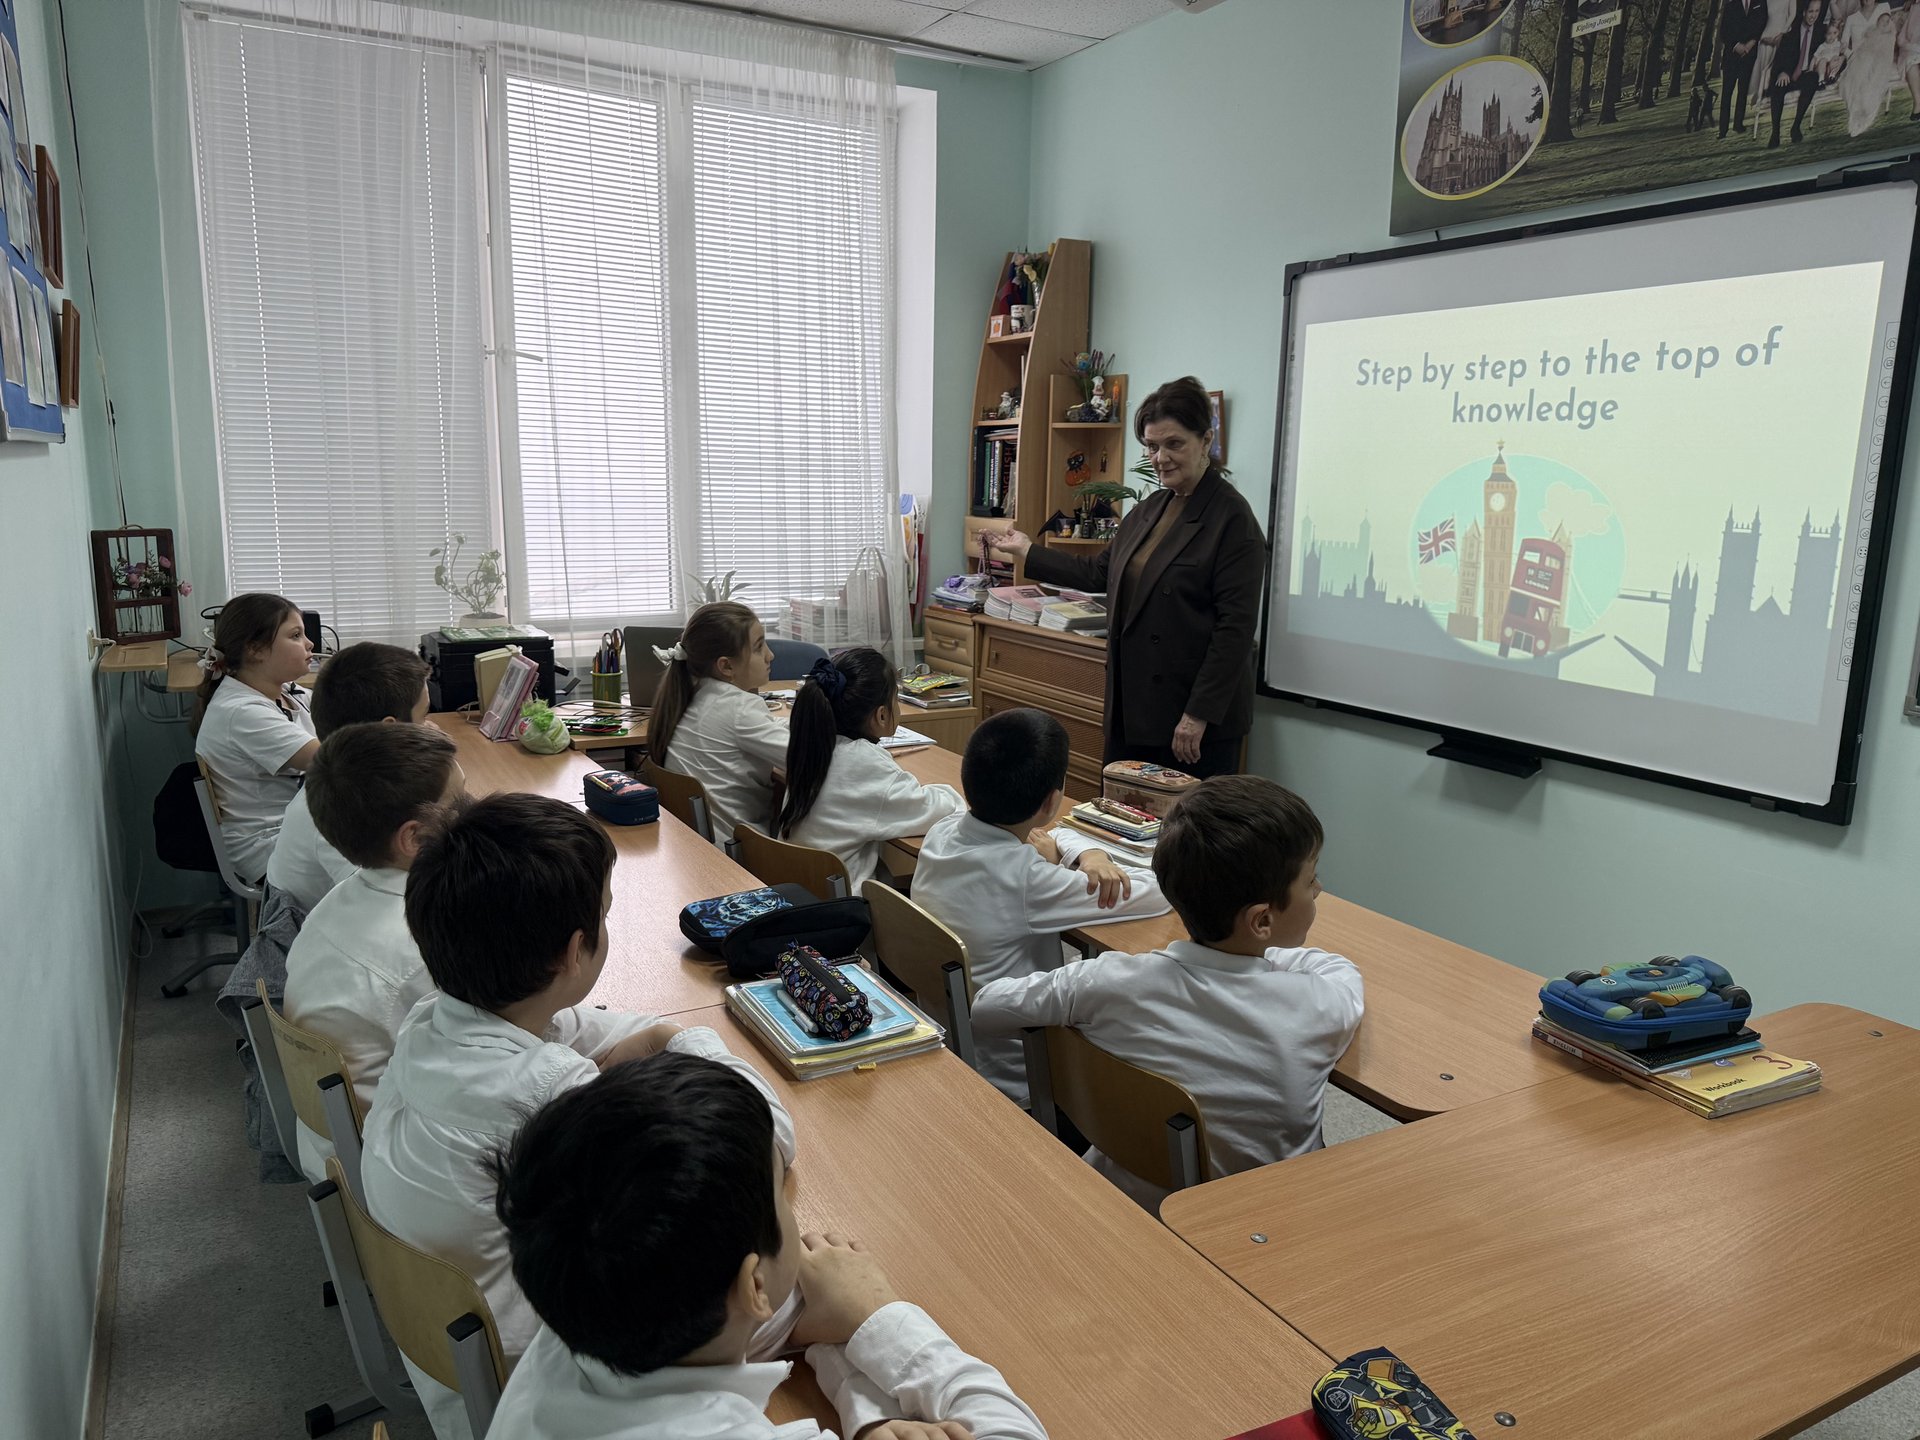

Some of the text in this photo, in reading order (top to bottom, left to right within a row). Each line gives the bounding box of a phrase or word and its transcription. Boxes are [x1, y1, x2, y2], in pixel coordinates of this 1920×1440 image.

[1576, 14, 1618, 32] Kipling Joseph
[1355, 325, 1784, 393] Step by step to the top of
[1451, 386, 1619, 431] knowledge
[1525, 579, 1549, 591] LONDON
[1752, 1055, 1793, 1070] 3
